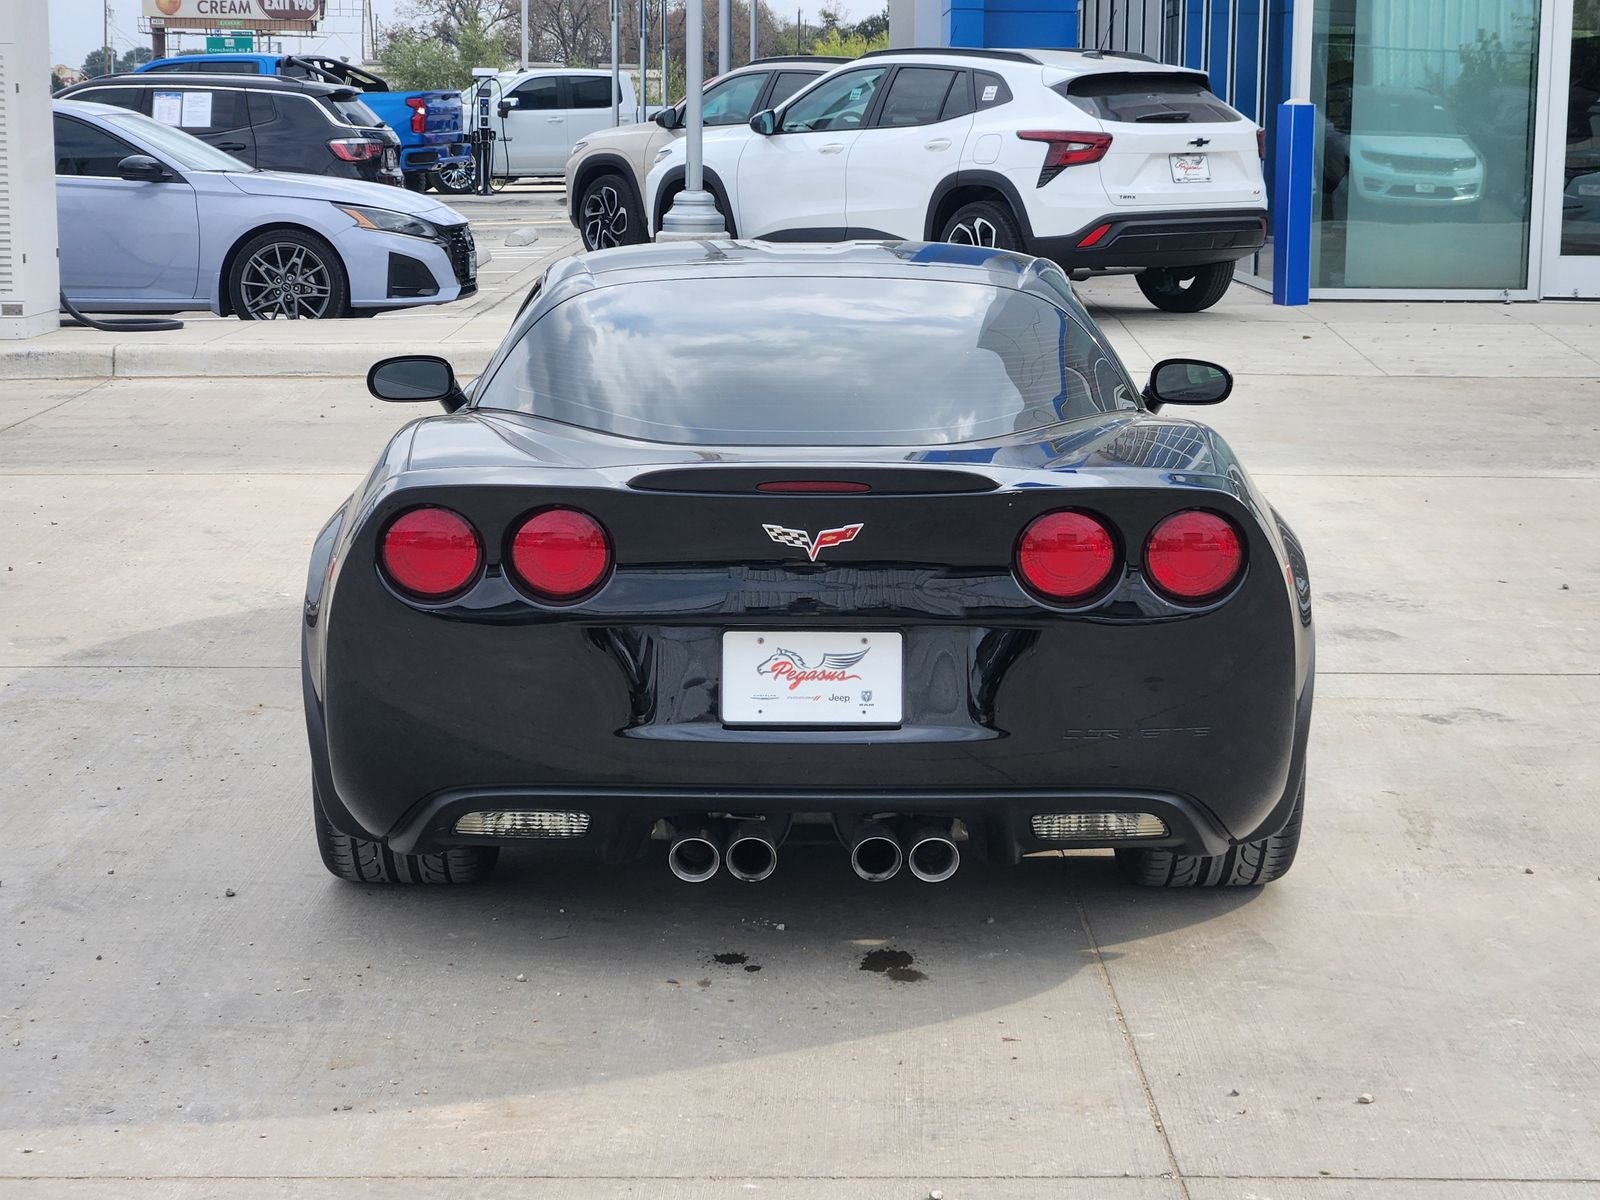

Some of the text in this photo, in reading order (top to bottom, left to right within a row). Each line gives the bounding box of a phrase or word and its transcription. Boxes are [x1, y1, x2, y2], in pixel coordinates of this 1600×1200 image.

[197, 0, 252, 14] CREAM
[264, 0, 315, 11] EXIT 198
[771, 661, 862, 690] Pegasus
[828, 694, 850, 703] Jeep
